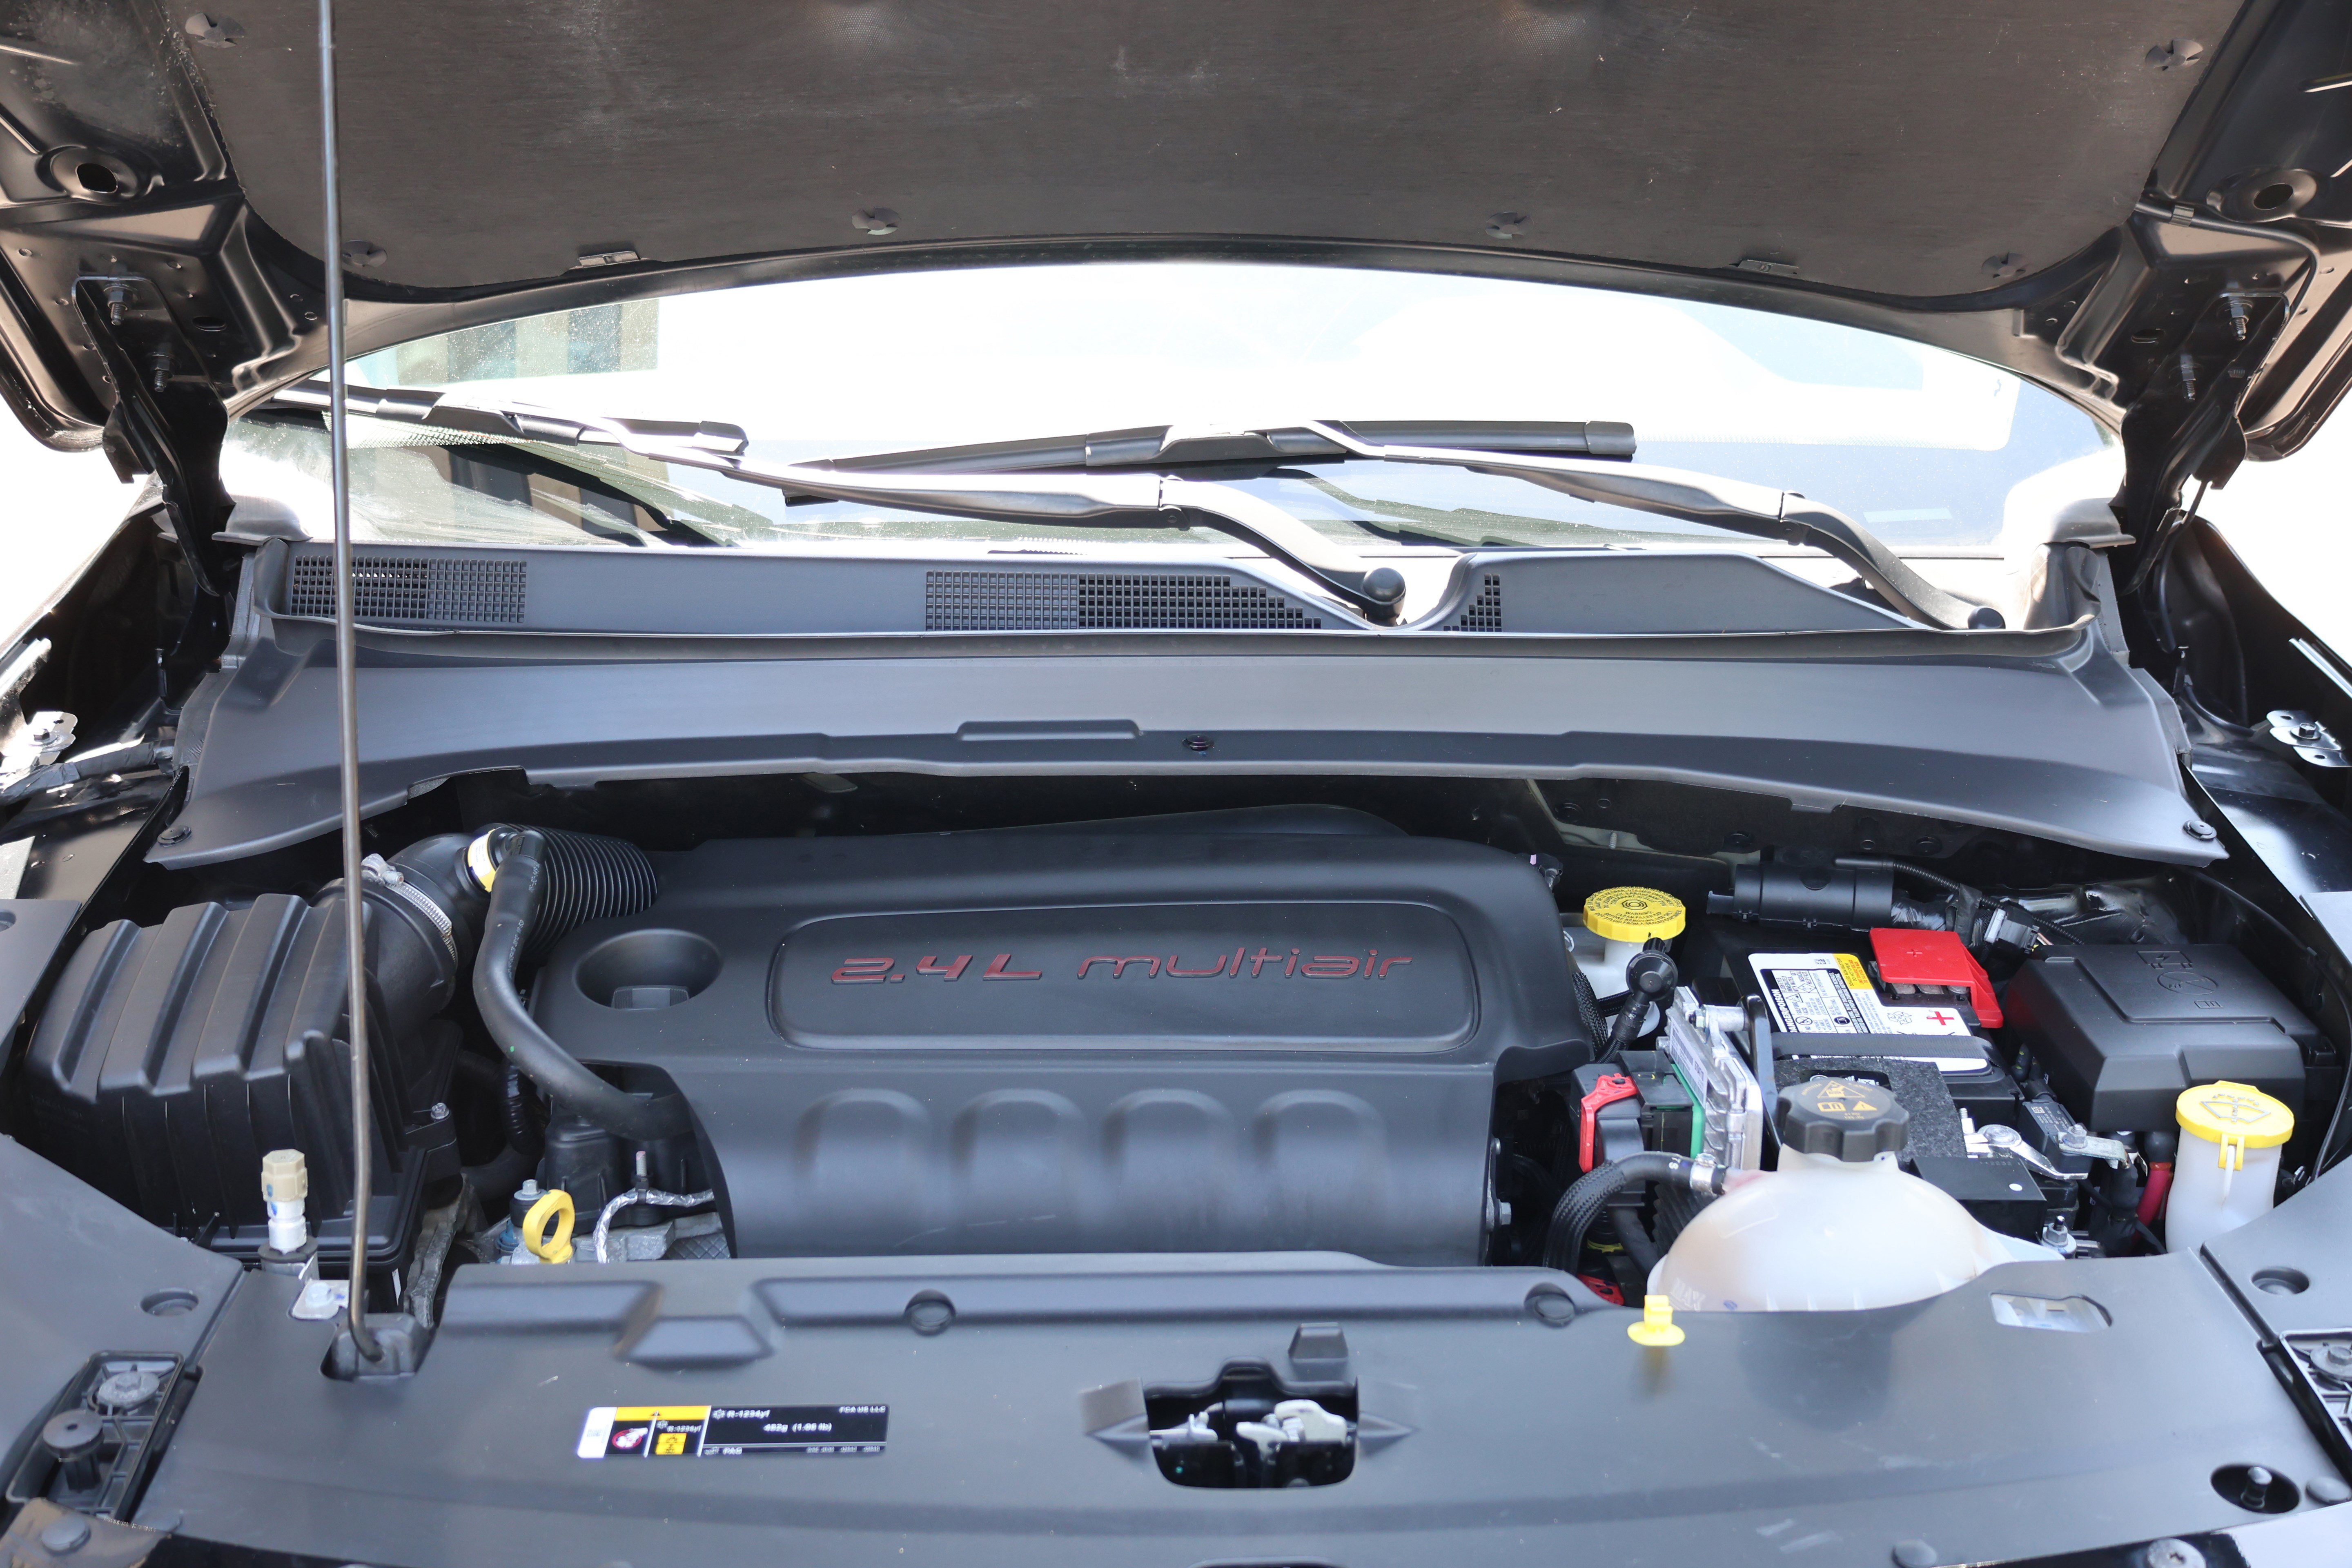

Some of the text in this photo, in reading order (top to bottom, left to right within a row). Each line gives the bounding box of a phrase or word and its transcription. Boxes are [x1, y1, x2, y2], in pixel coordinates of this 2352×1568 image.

[1077, 947, 1413, 979] multiair
[1836, 958, 1845, 969] BATTERY
[1846, 976, 1854, 987] SEALED
